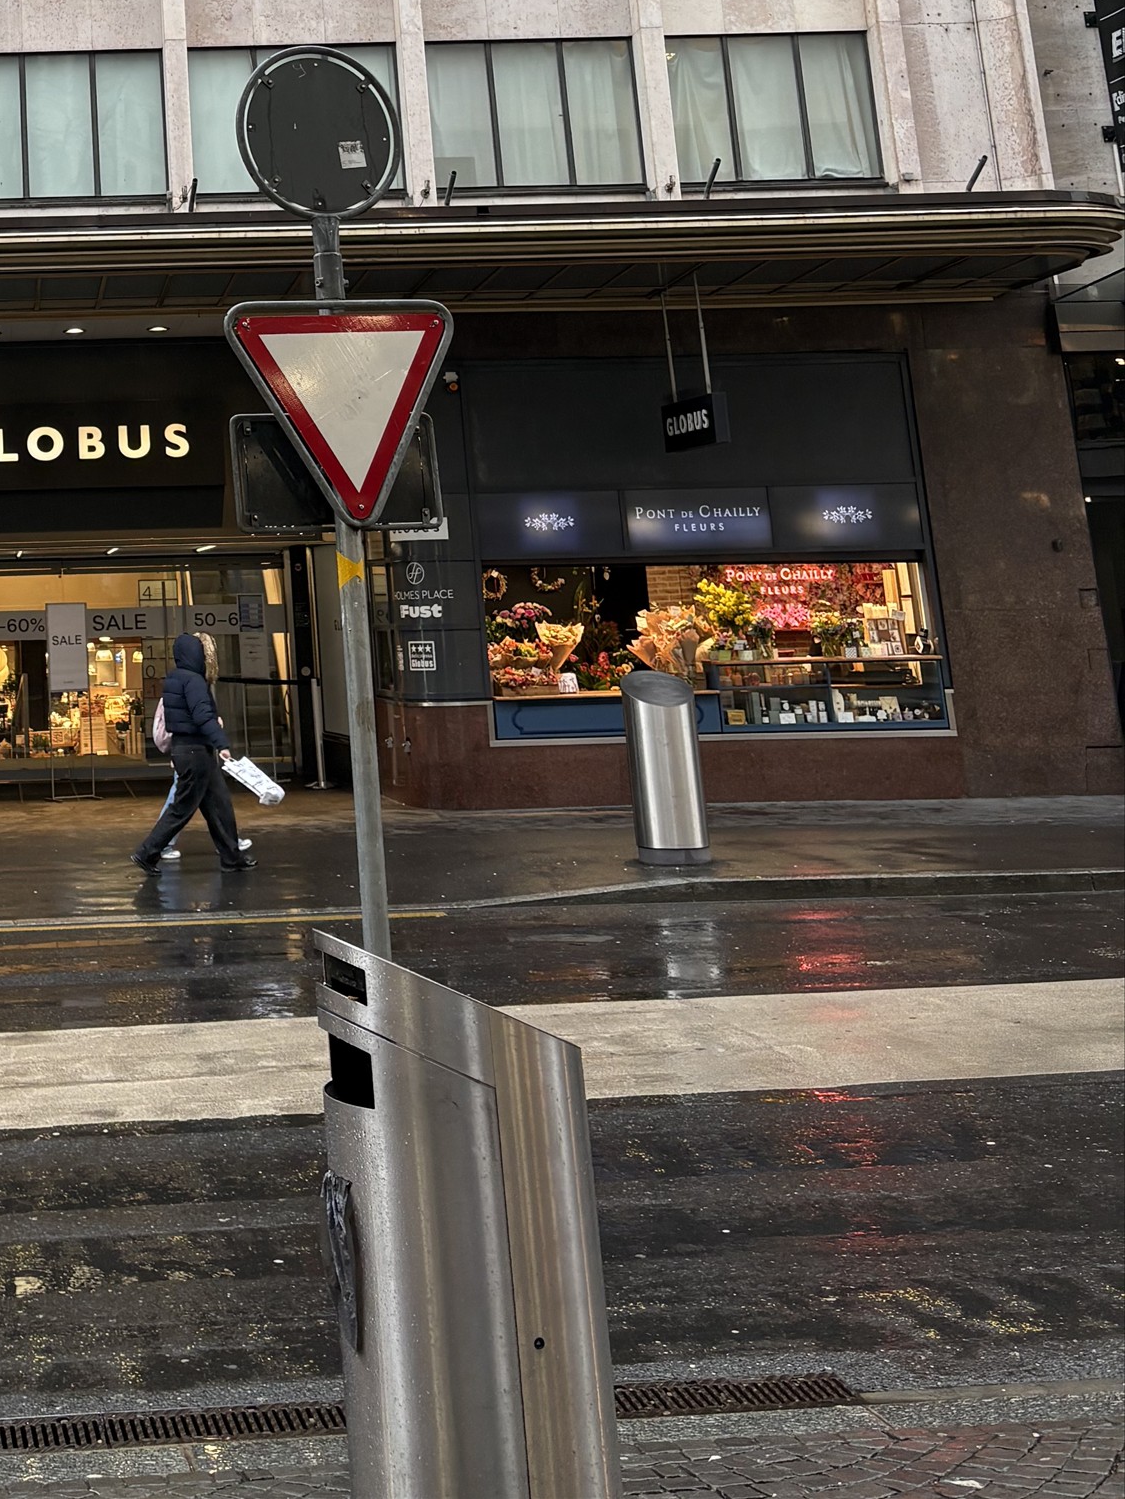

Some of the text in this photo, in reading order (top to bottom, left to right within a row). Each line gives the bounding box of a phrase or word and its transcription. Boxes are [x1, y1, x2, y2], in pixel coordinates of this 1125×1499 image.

[666, 408, 710, 436] GLOBUS
[635, 505, 761, 519] PONT DE CHAILLY
[675, 522, 725, 532] FLEURS
[726, 569, 761, 582] PONT
[780, 568, 834, 580] CHAILLY
[142, 585, 152, 599] 4
[394, 589, 454, 600] OLMES PLACE
[760, 586, 804, 595] FLEURS
[92, 613, 147, 632] SALE
[193, 612, 238, 627] 50-6
[51, 635, 82, 646] SALE
[145, 664, 156, 678] 0
